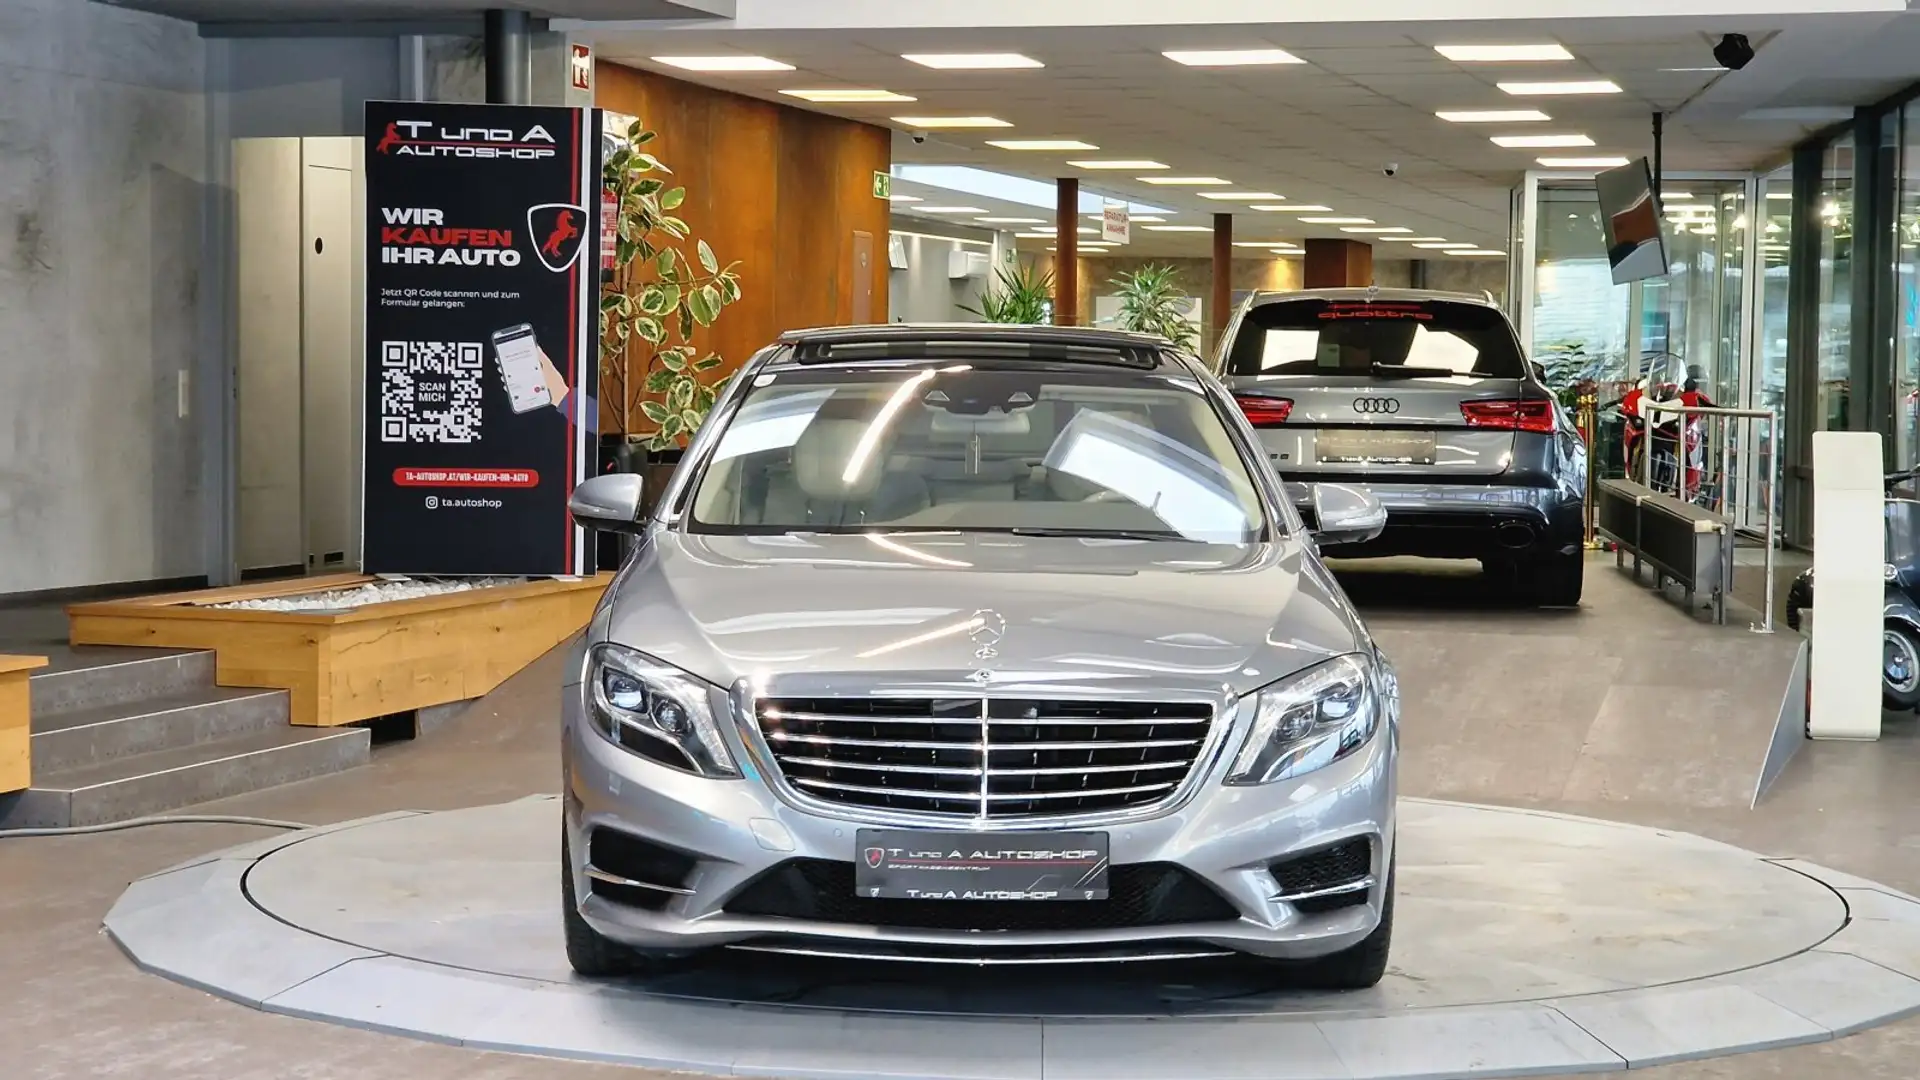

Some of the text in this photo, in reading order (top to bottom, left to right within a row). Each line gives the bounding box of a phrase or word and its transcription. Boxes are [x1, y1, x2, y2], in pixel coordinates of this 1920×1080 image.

[396, 120, 432, 138] T
[520, 125, 556, 142] A
[396, 145, 556, 160] AUTOSHOP
[381, 207, 444, 226] WIR
[381, 227, 512, 247] KAUFEN
[381, 247, 521, 267] IHR AUTO
[381, 288, 520, 299] Jetzt QR Code scannen und zum
[381, 298, 420, 306] Formular
[1318, 310, 1434, 320] quattro
[418, 382, 446, 392] SCAN
[418, 392, 446, 402] MICH
[442, 498, 502, 509] ta.autoshop
[887, 848, 904, 857] T
[947, 849, 963, 859] A
[969, 849, 1099, 860] AUTOSHOP
[962, 890, 1058, 901] AUTOSHOP
